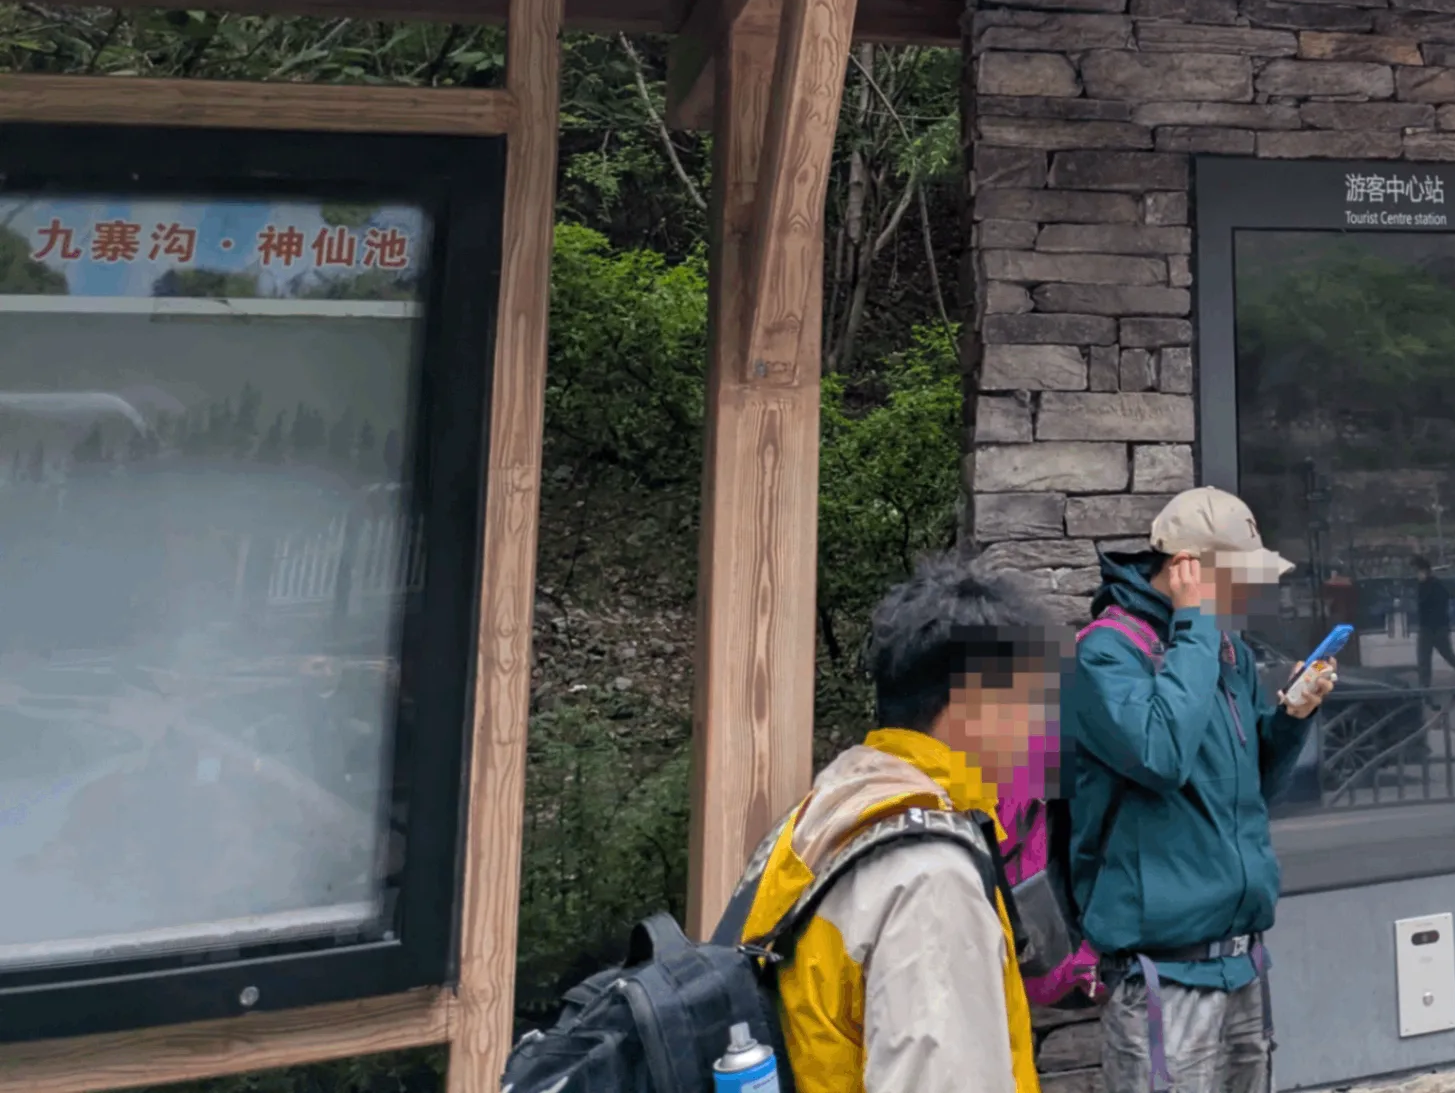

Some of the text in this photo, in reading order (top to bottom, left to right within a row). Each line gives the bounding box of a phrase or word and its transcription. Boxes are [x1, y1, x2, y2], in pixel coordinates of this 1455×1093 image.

[1345, 173, 1445, 205] 游客中心站
[1345, 210, 1447, 226] Tourist Centre station
